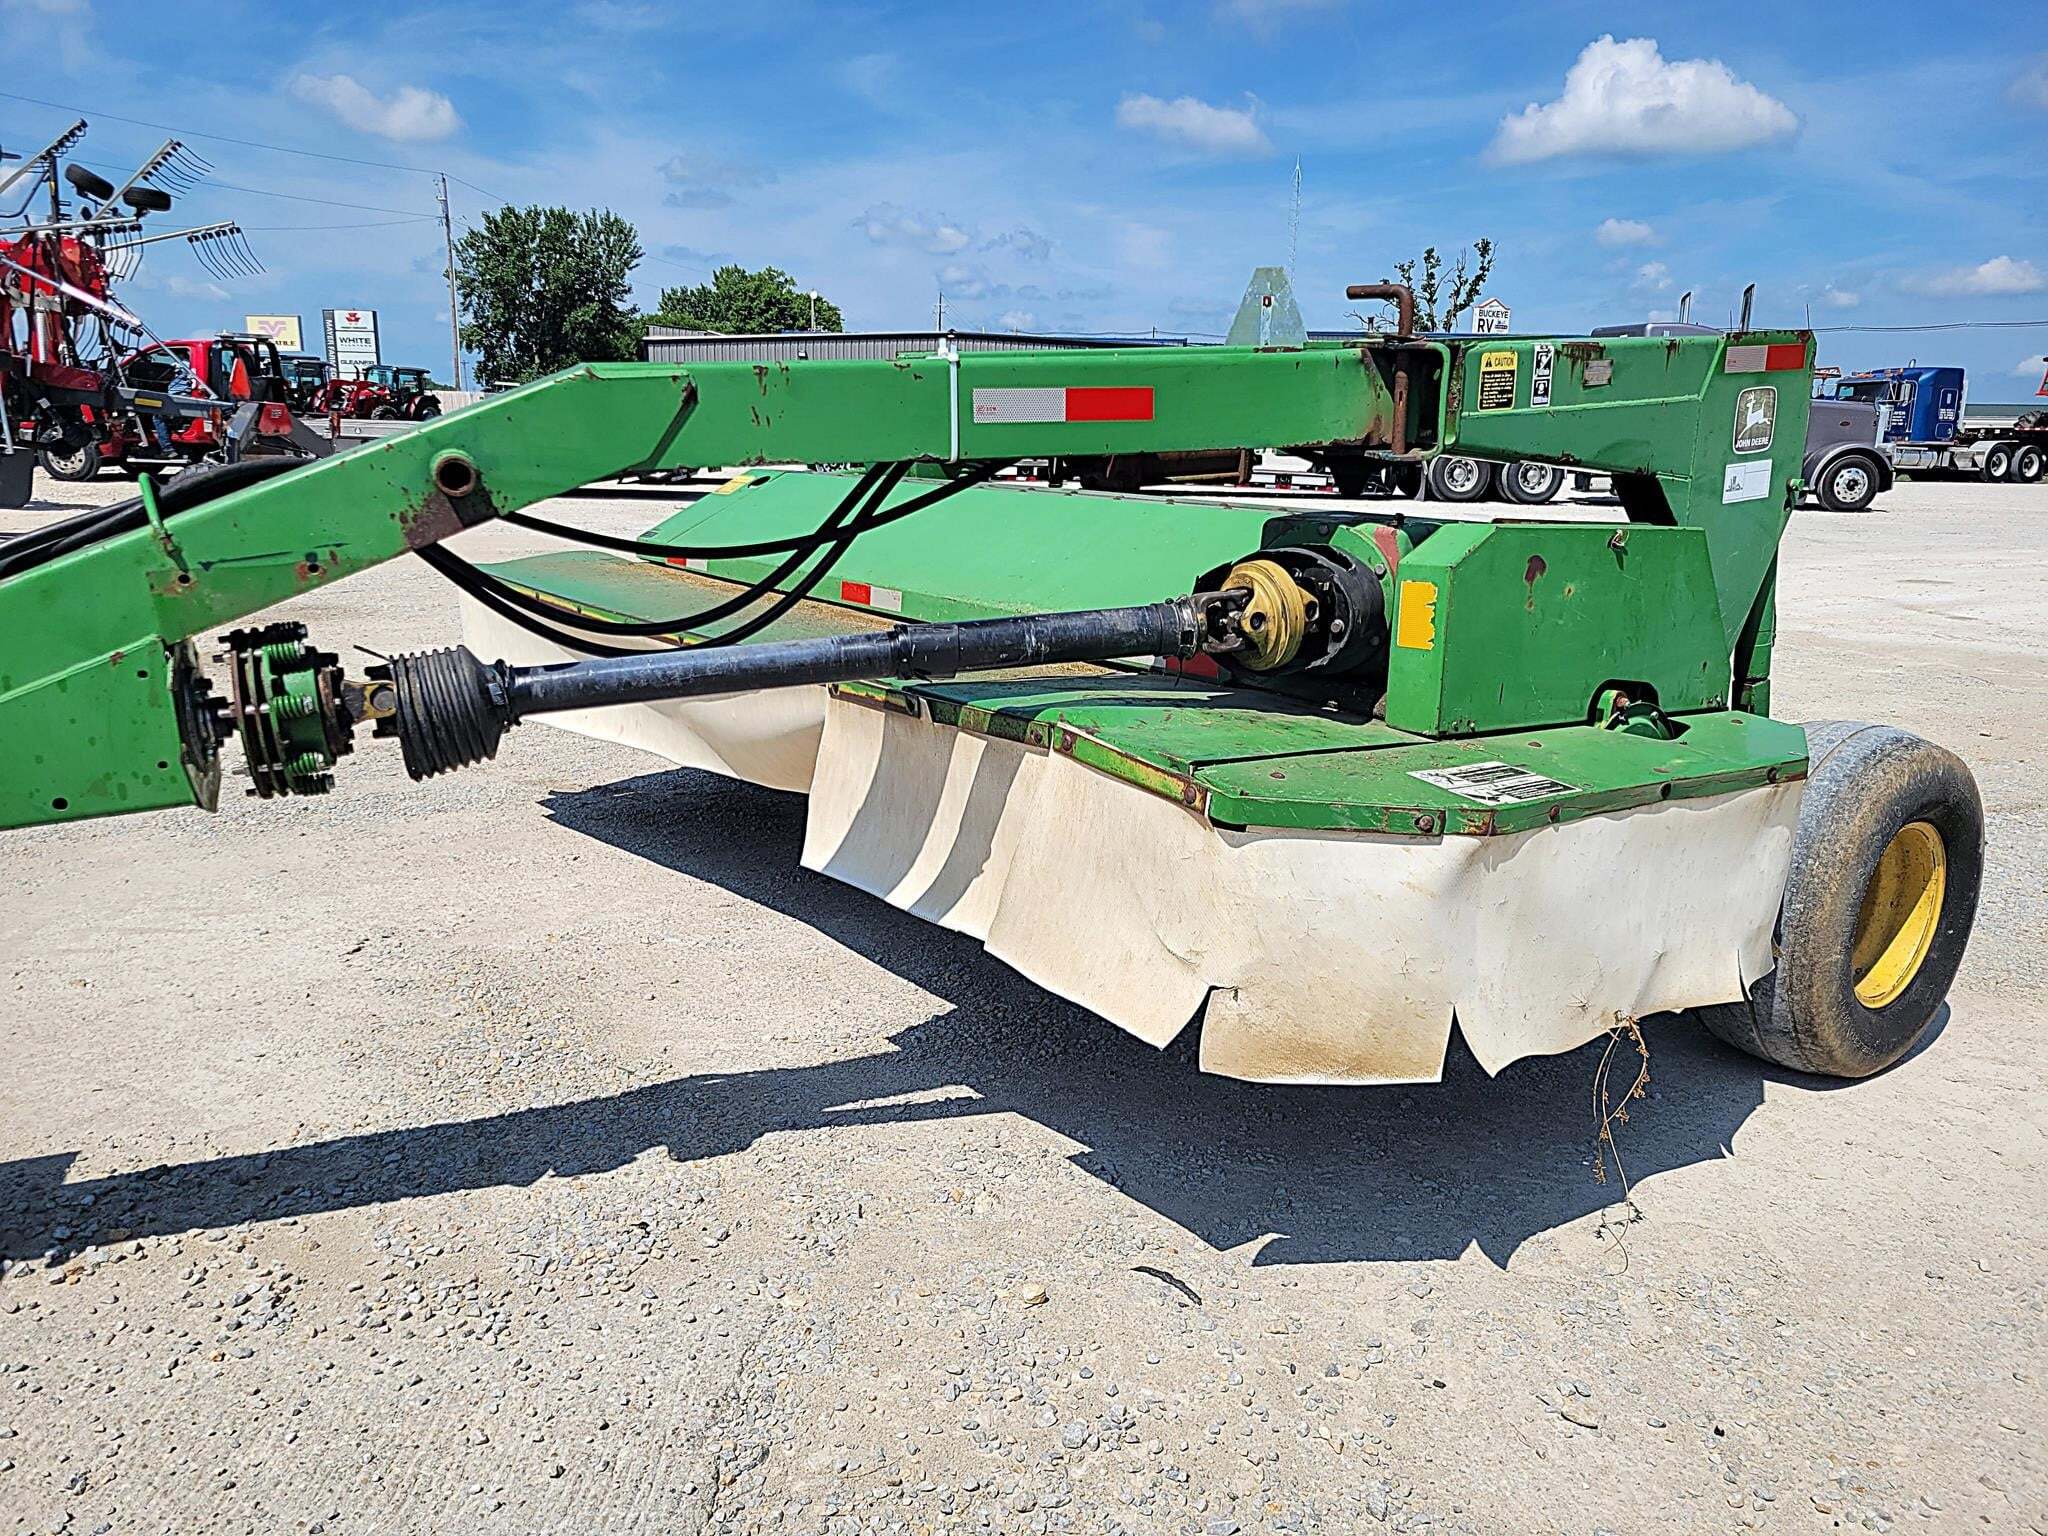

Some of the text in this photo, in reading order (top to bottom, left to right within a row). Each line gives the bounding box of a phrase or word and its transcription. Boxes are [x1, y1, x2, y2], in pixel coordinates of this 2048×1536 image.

[1478, 309, 1509, 319] BUCKEYE
[325, 319, 335, 345] MAYER
[1477, 318, 1494, 333] RV
[1494, 357, 1514, 366] CAUTION
[1735, 436, 1770, 449] JOHN DEERE
